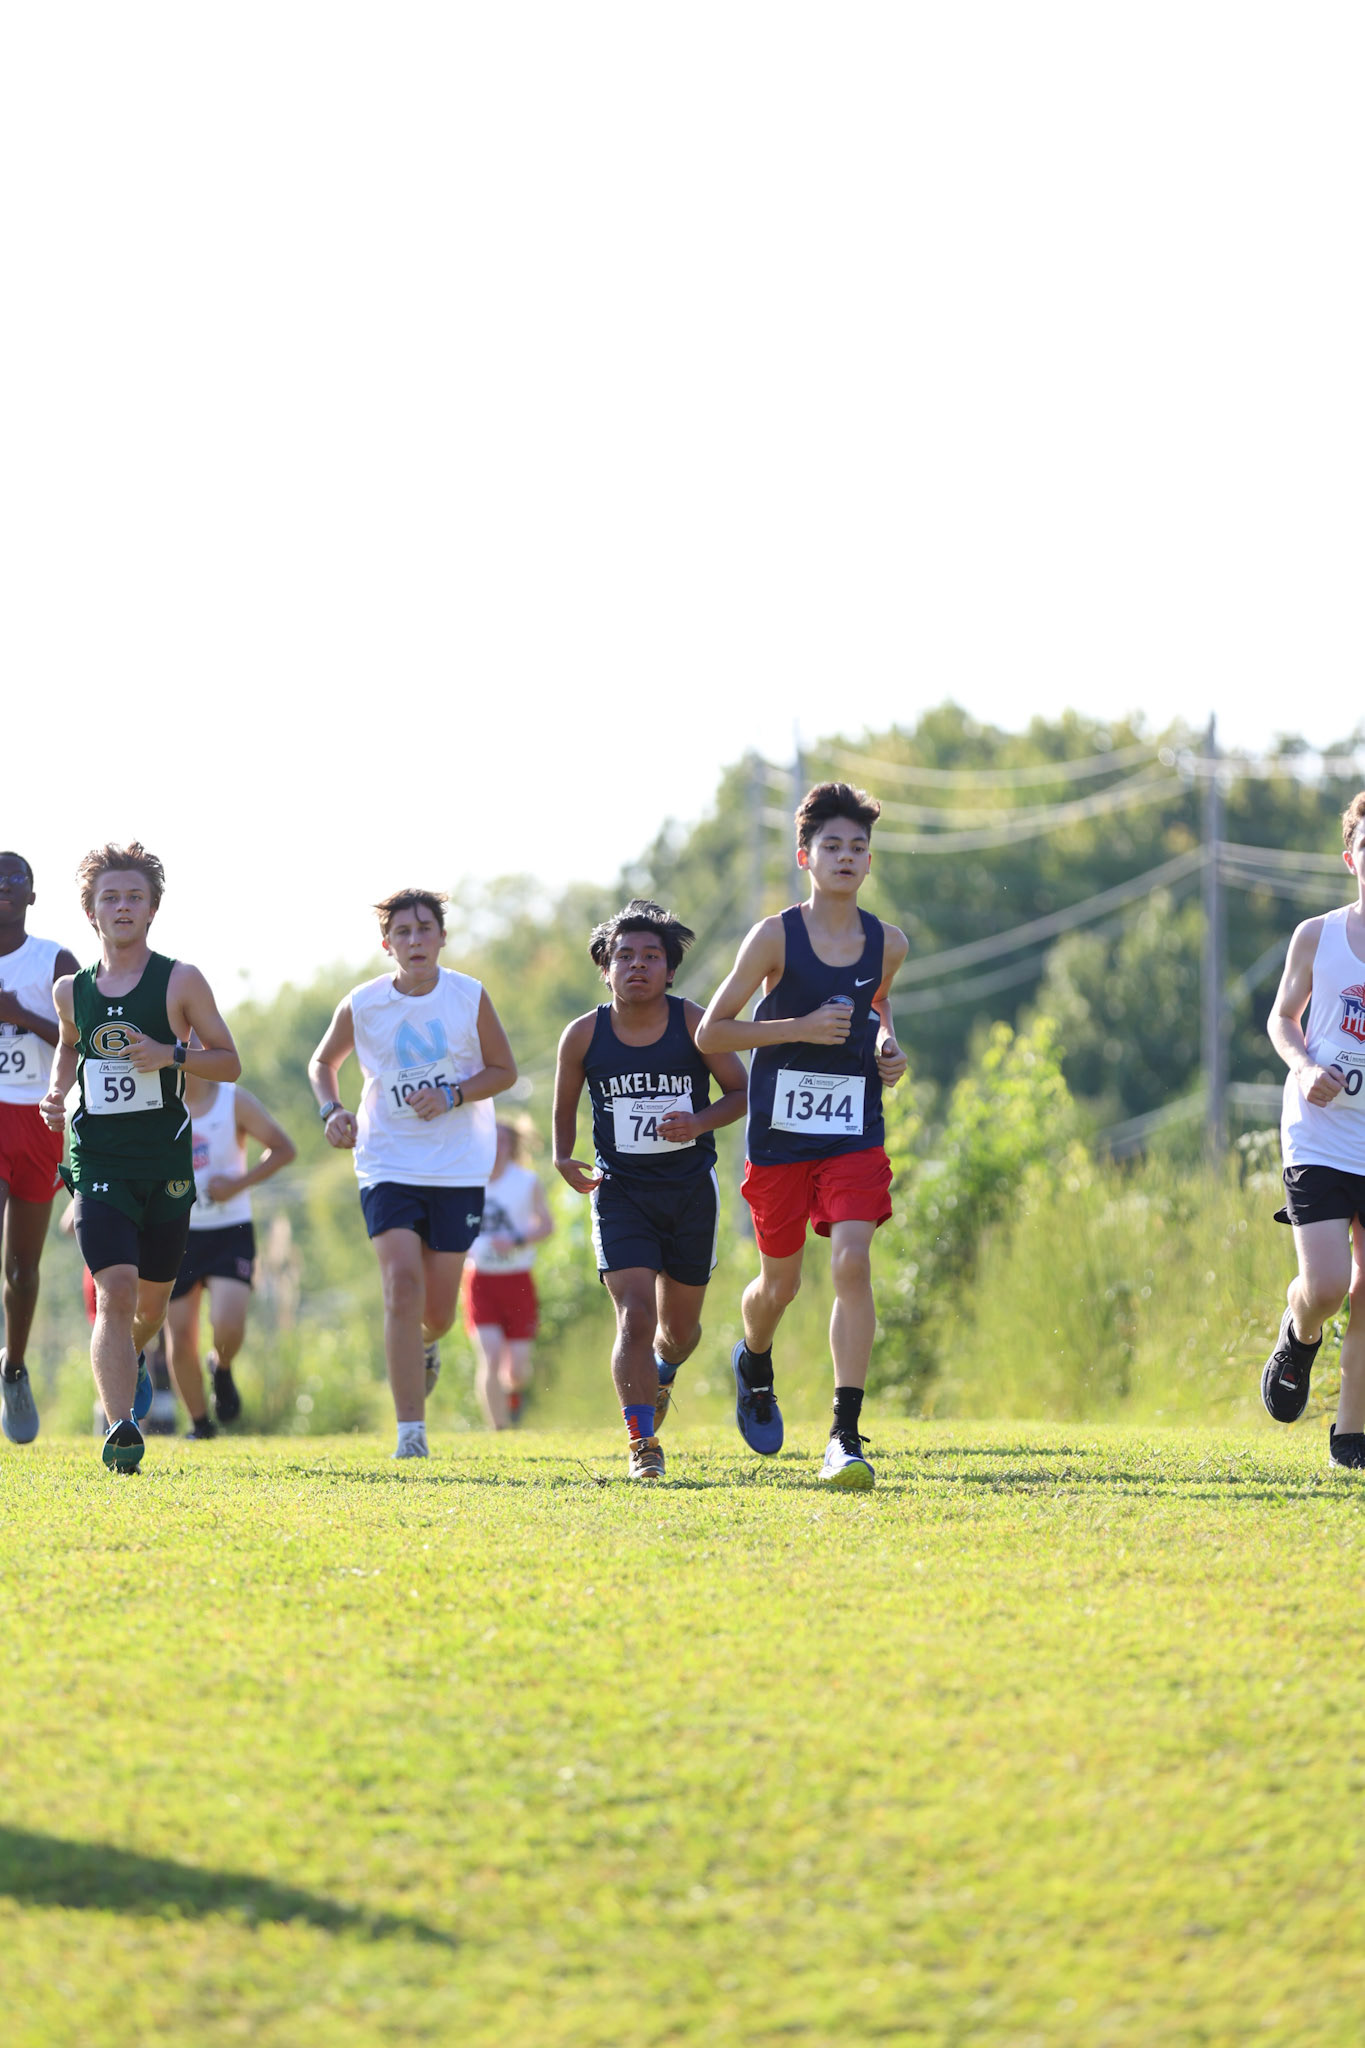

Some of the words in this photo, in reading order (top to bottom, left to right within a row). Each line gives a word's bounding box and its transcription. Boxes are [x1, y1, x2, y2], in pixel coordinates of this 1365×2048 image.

[395, 1018, 448, 1069] N
[104, 1076, 136, 1103] 59
[600, 1072, 693, 1098] LAKELAND
[785, 1089, 854, 1123] 1344
[629, 1115, 667, 1142] 74
